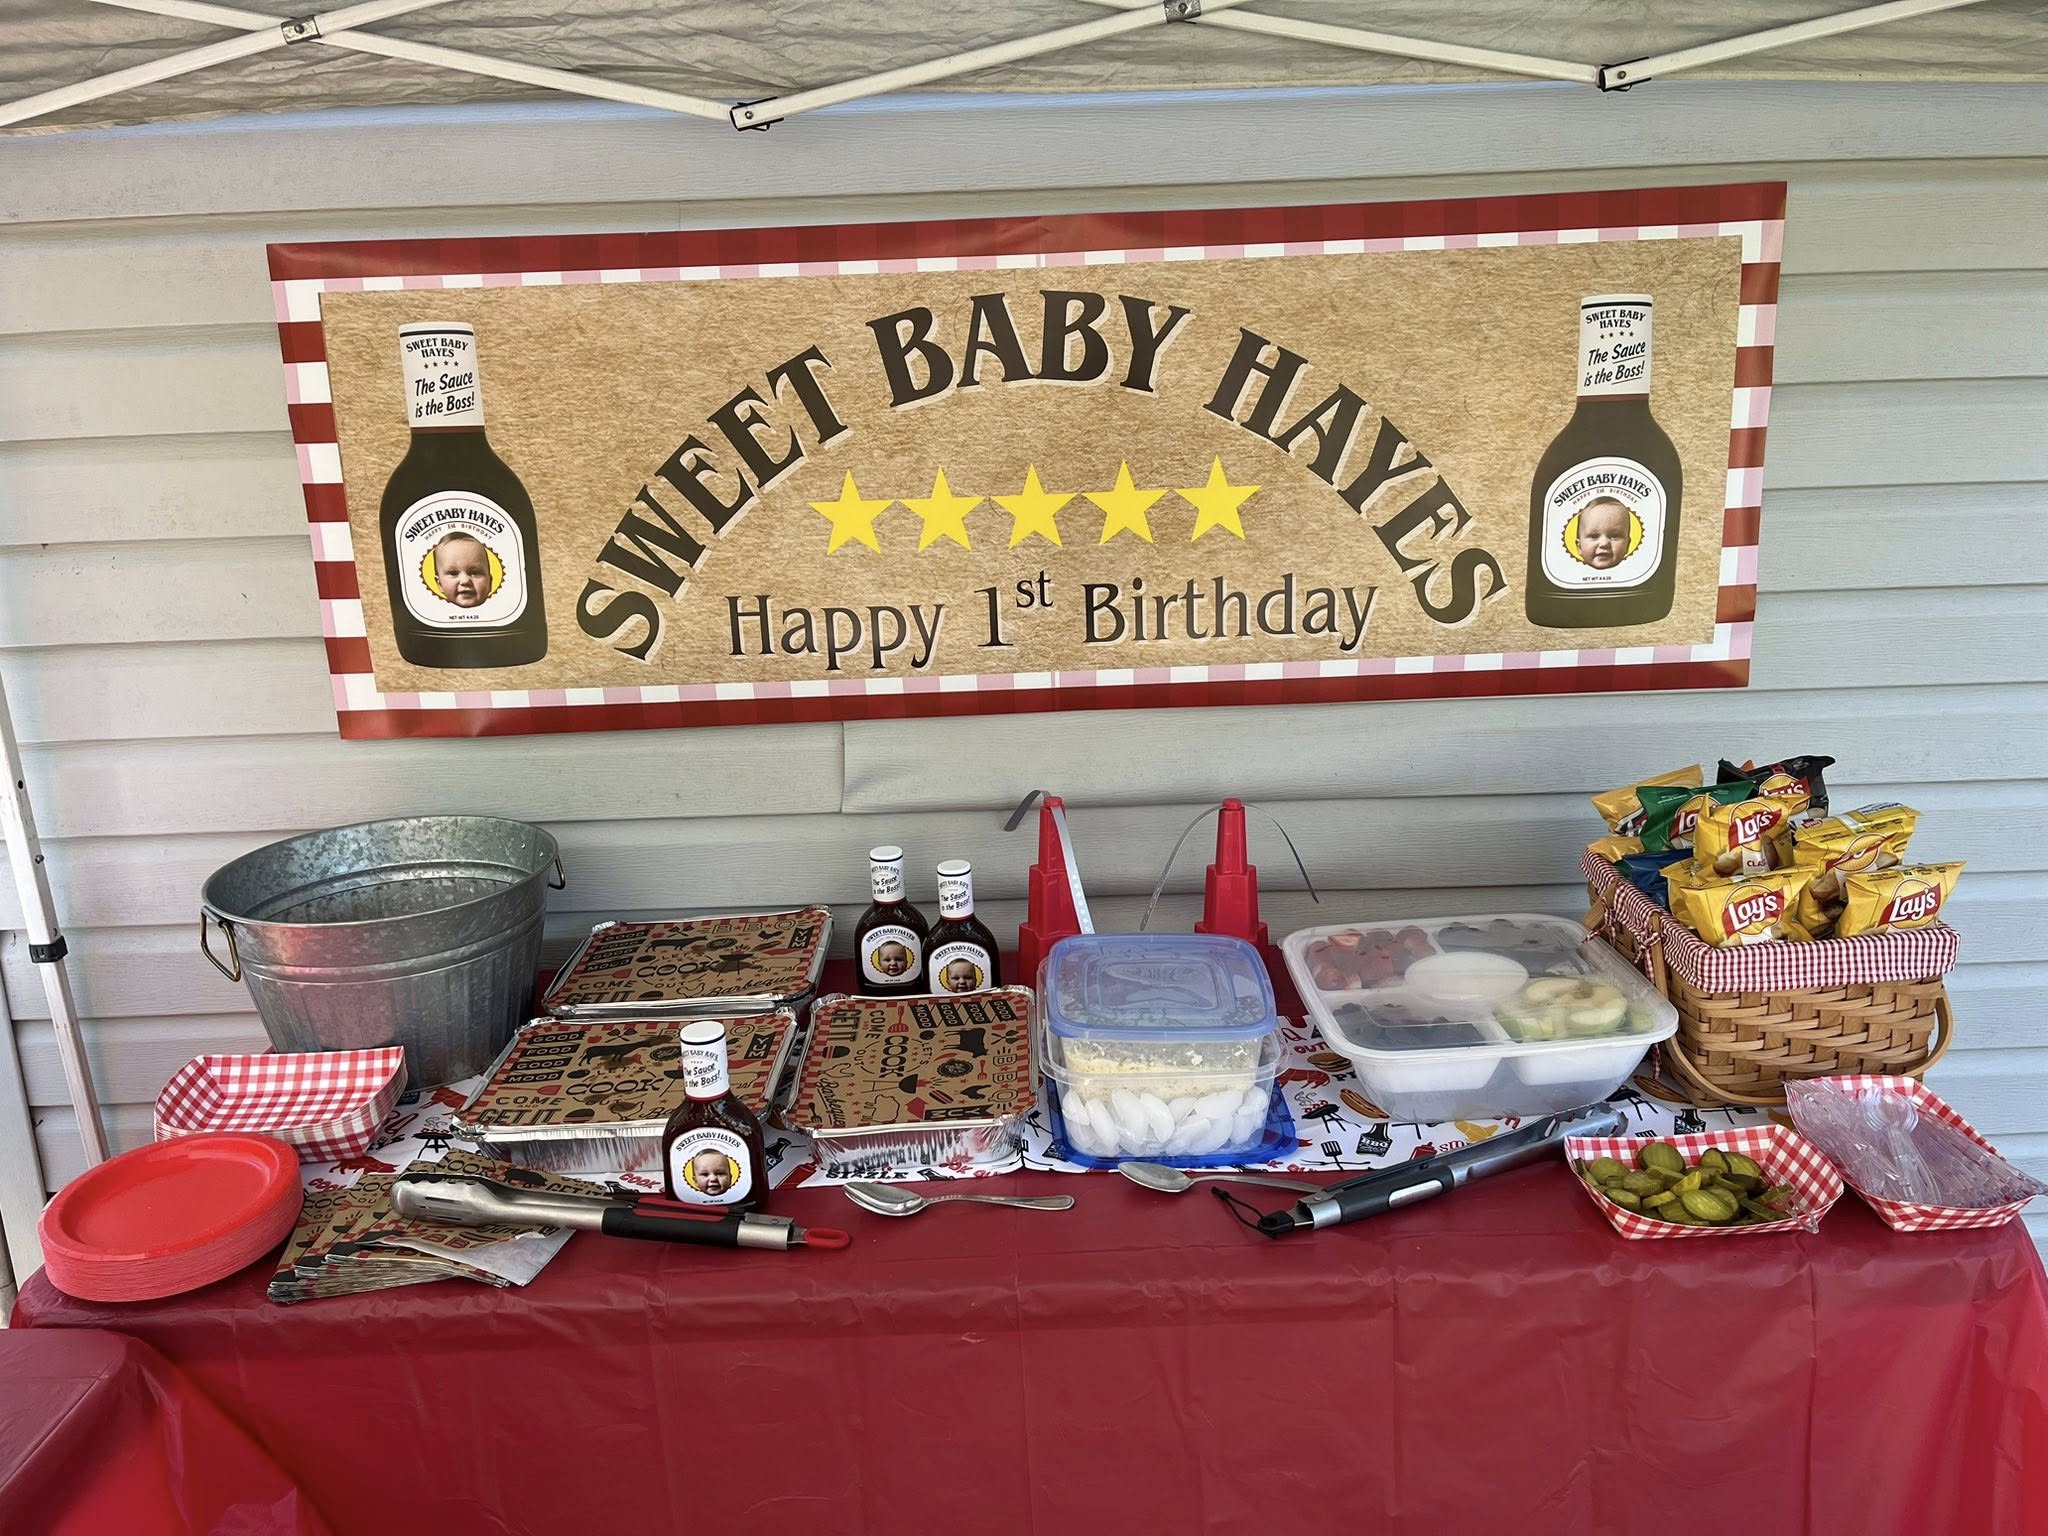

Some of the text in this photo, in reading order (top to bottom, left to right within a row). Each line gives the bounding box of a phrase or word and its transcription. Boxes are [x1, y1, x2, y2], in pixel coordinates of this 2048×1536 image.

[1585, 309, 1646, 324] SWEET BABY
[1599, 319, 1632, 329] HAYES
[406, 338, 469, 353] SWEET BABY
[421, 348, 455, 358] HAYES
[1588, 341, 1646, 366] The Sauce
[1583, 360, 1645, 387] is the Boss!
[415, 372, 473, 396] The Sauce
[415, 391, 475, 418] is the Boss!
[576, 290, 1510, 663] SWEET BABY HAYES
[1554, 473, 1652, 507] SWEET BABY HAYES
[405, 508, 505, 542] SWEET BABY HAYES
[725, 570, 1379, 672] Happy 1st Birthday
[1728, 893, 1778, 931] Lay's
[1888, 888, 1937, 922] Lay's
[790, 930, 809, 948] YUM
[637, 960, 719, 977] COOK
[578, 980, 637, 991] COME
[916, 1005, 932, 1028] MOOD
[941, 1003, 958, 1025] GOOD
[865, 1009, 886, 1039] COME
[533, 1033, 580, 1043] GOOD
[526, 1047, 572, 1056] FOOD
[748, 1037, 770, 1058] YUM
[920, 1042, 933, 1066] LET'S
[516, 1060, 565, 1070] GOOD
[854, 1049, 866, 1066] OUT
[879, 1035, 910, 1079] COOK
[508, 1073, 559, 1082] MOOD
[689, 1079, 699, 1087] the
[701, 1069, 720, 1086] Boss!
[693, 1063, 715, 1076] Sauce
[566, 1078, 665, 1095] COOK
[495, 1095, 566, 1105] COME
[478, 1109, 563, 1126] GET IT
[930, 1107, 980, 1118] YUM
[676, 1134, 696, 1151] SWEET
[717, 1133, 741, 1148] HAYES
[619, 1173, 661, 1189] COOK
[826, 1167, 909, 1179] SIZZLE
